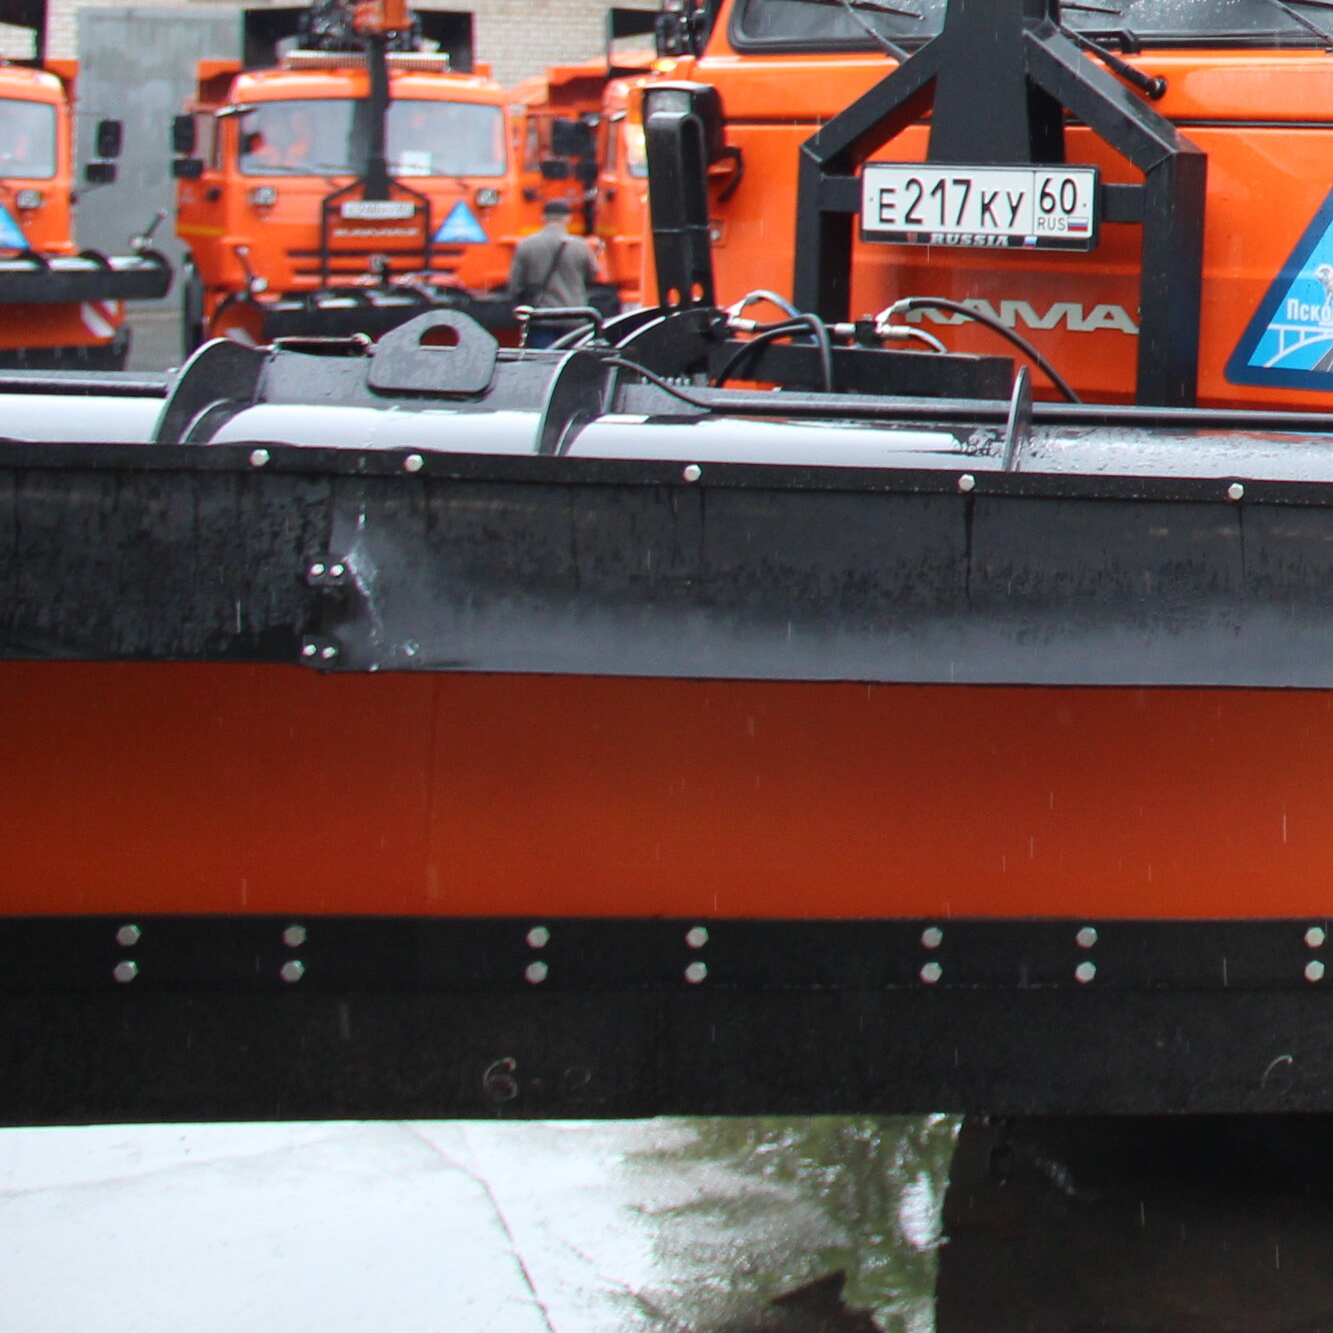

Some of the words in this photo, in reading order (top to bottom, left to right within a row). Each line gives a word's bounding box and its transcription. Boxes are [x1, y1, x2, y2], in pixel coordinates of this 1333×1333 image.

[1039, 178, 1077, 215] 60
[1037, 217, 1065, 230] RUS
[930, 233, 1009, 247] RUSSIA
[905, 297, 1140, 334] KAMA
